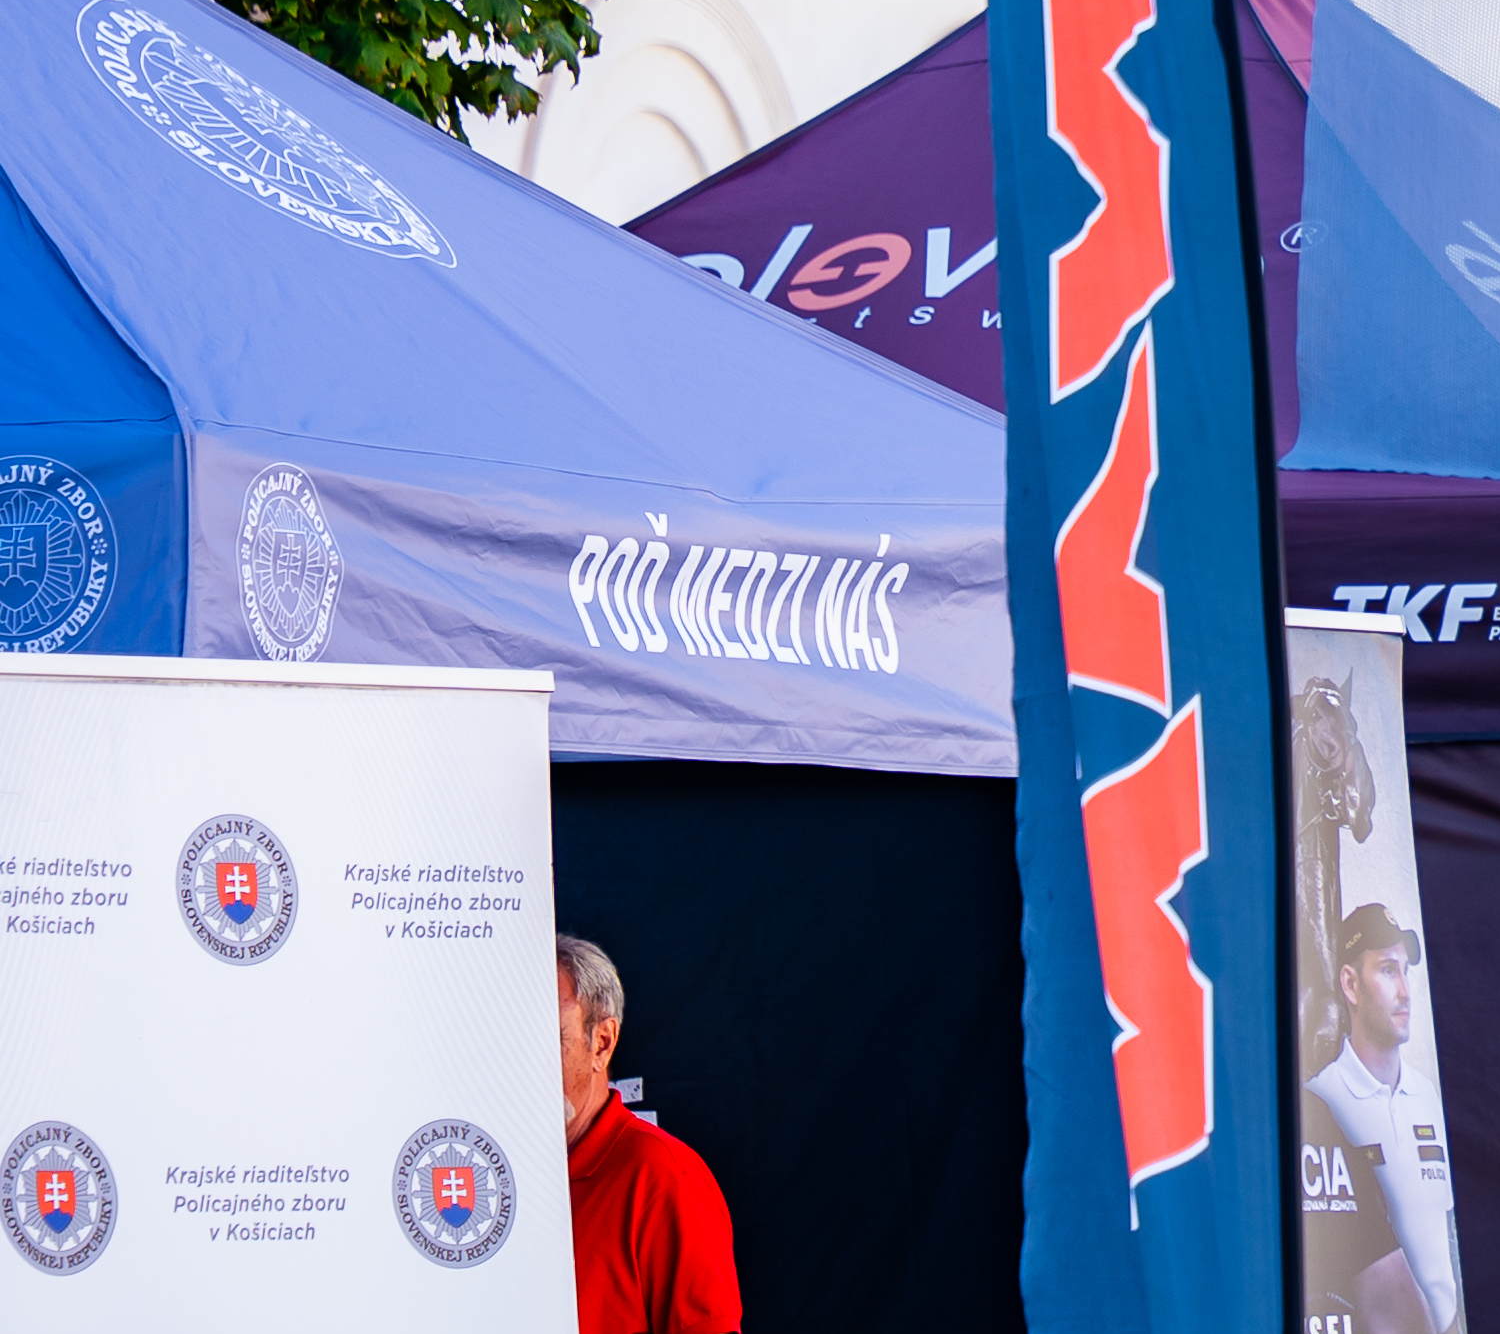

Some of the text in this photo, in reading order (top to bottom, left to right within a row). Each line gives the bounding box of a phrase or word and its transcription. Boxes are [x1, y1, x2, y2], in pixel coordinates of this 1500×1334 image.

[57, 478, 104, 539] ZBOR
[568, 512, 910, 674] POĎ MEDZI NÁS
[1333, 583, 1498, 643] TKF
[182, 819, 287, 875] POLICAJNÝ ZBOR
[23, 858, 132, 878] riaditeľstvo
[343, 864, 525, 885] Krajské riaditeľstvo
[71, 890, 128, 906] zboru
[351, 892, 521, 913] Policajného zboru
[6, 915, 95, 934] Košiciach
[180, 888, 293, 960] SLOVENSKEJ REPUBLIKY
[385, 920, 493, 939] v Košiciach
[3, 1126, 108, 1183] POLICAJNÝ ZBOR
[398, 1123, 507, 1178] POLICAJNÝ ZBOR
[165, 1164, 350, 1187] Krajské riaditeľstvo
[173, 1194, 346, 1215] Policajného zboru
[209, 1222, 315, 1241] v Košiciach
[397, 1192, 512, 1263] SLOVENSKEJ REPUBLIKY
